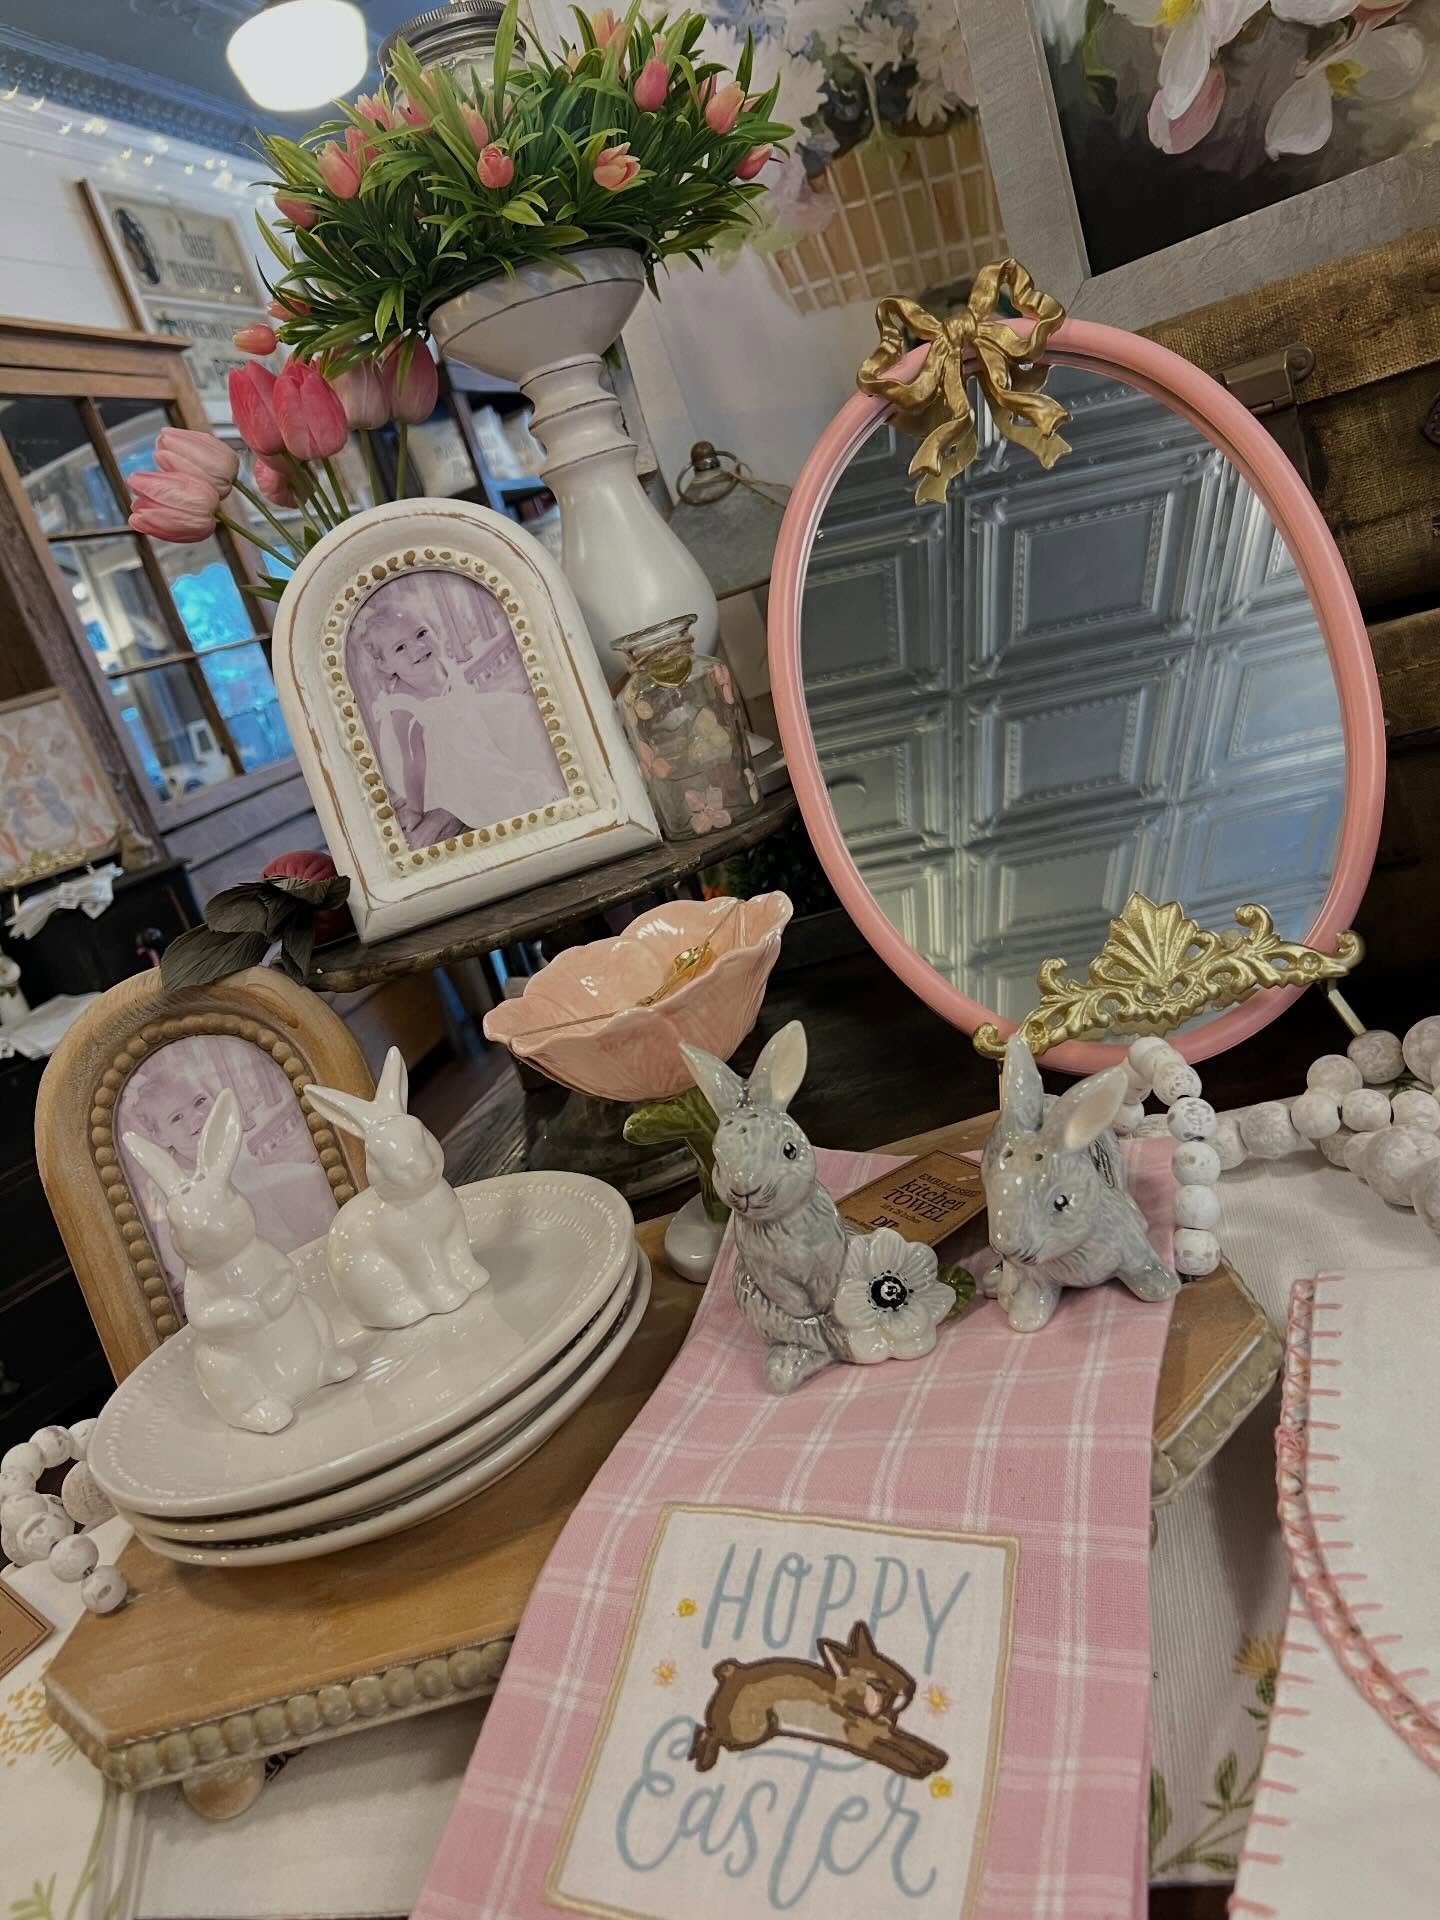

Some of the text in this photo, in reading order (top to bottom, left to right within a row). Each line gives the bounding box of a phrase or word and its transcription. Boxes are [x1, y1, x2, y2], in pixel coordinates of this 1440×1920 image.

[882, 1188, 950, 1223] TOWEL
[899, 1178, 967, 1212] kitchen
[701, 1542, 972, 1677] HOPPY
[615, 1715, 938, 1911] Easter
